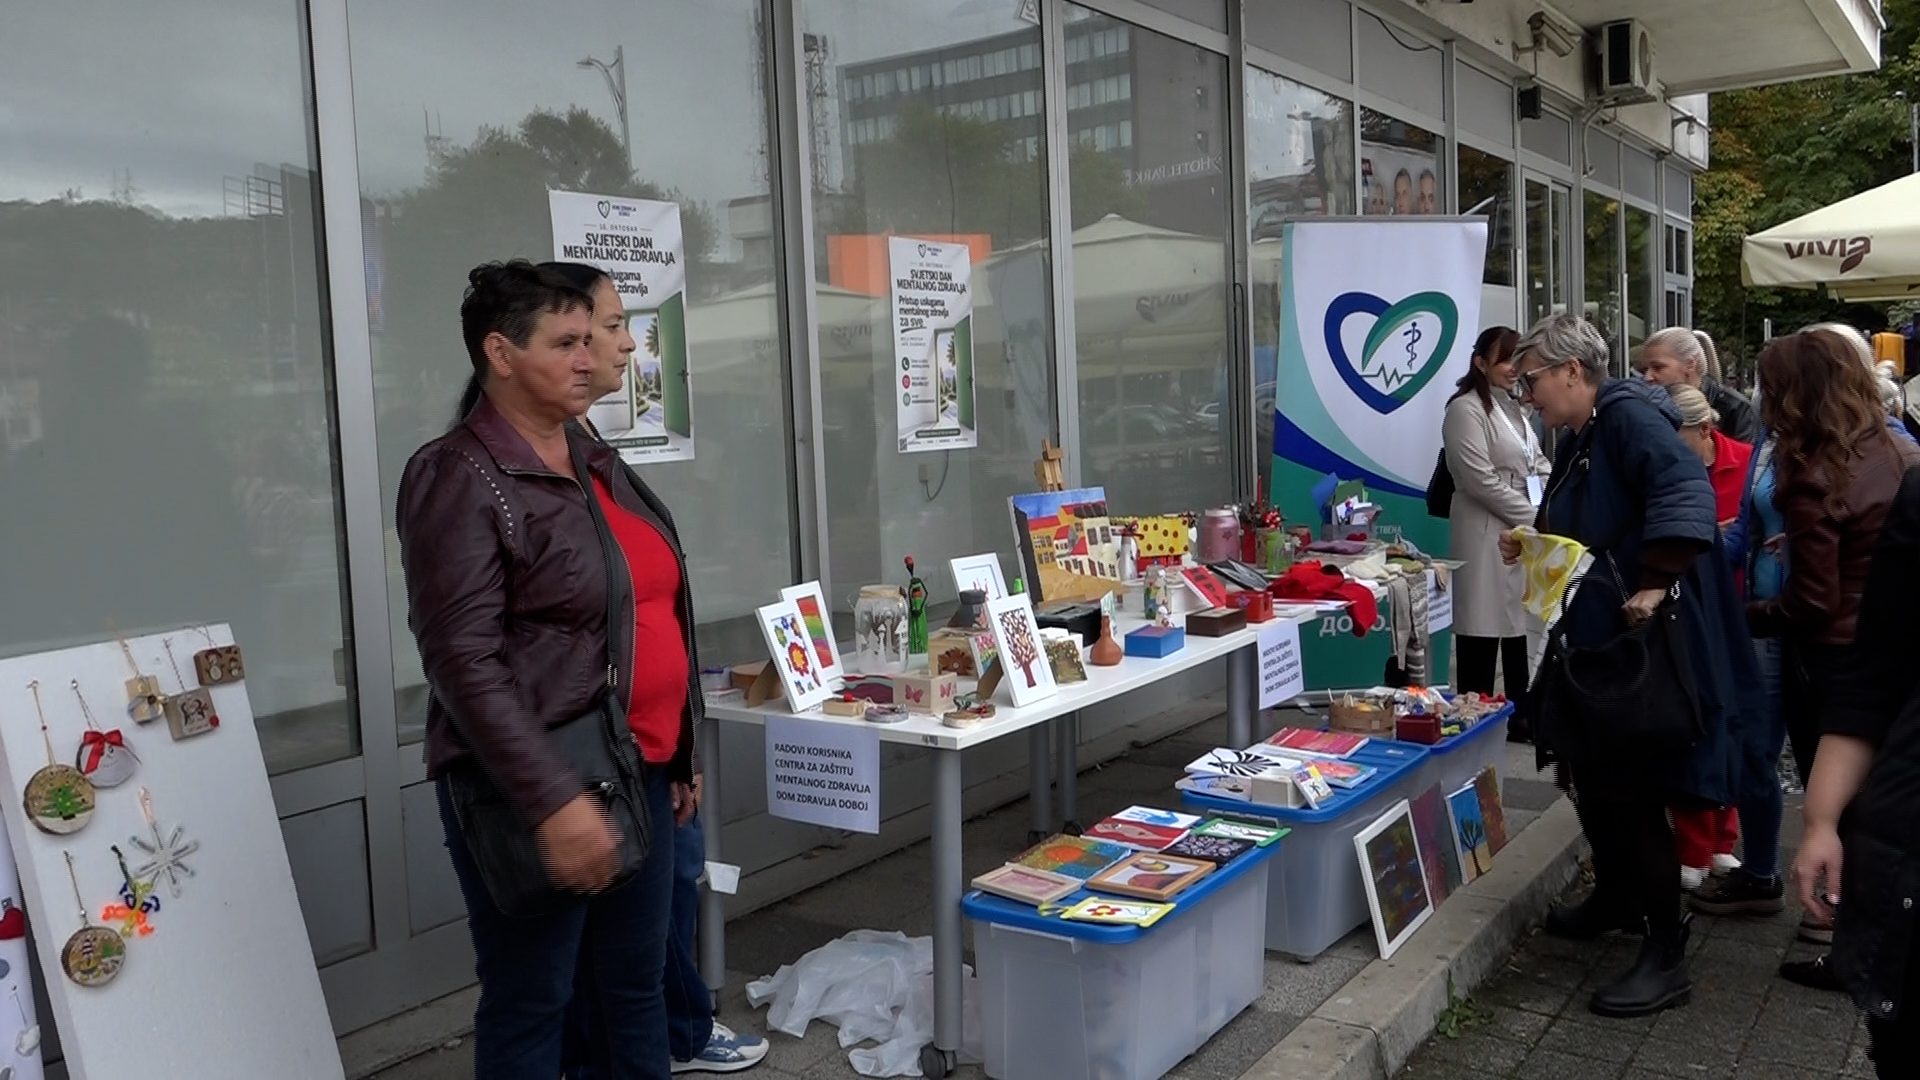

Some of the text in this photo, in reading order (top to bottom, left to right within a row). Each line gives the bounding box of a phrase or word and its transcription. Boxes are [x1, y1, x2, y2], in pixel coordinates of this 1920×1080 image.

[585, 232, 653, 249] SVJETSKI DAN
[563, 245, 676, 266] MENTALNOG ZDRAVLJA
[910, 269, 953, 282] SVJETSKI DAN
[617, 282, 649, 297] zdravlja
[897, 278, 967, 295] MENTALNOG ZDRAVLJA
[898, 295, 919, 306] Pristup
[900, 318, 924, 328] za sve
[1320, 614, 1391, 637] ДОО
[774, 743, 852, 760] RADOVI KORISNIKA
[774, 758, 854, 776] CENTRA ZA ZAŠTITU
[775, 774, 871, 794] MENTALNOG ZDRAVLJA
[776, 790, 868, 811] DOM ZDRAVLJA DOBOJ
